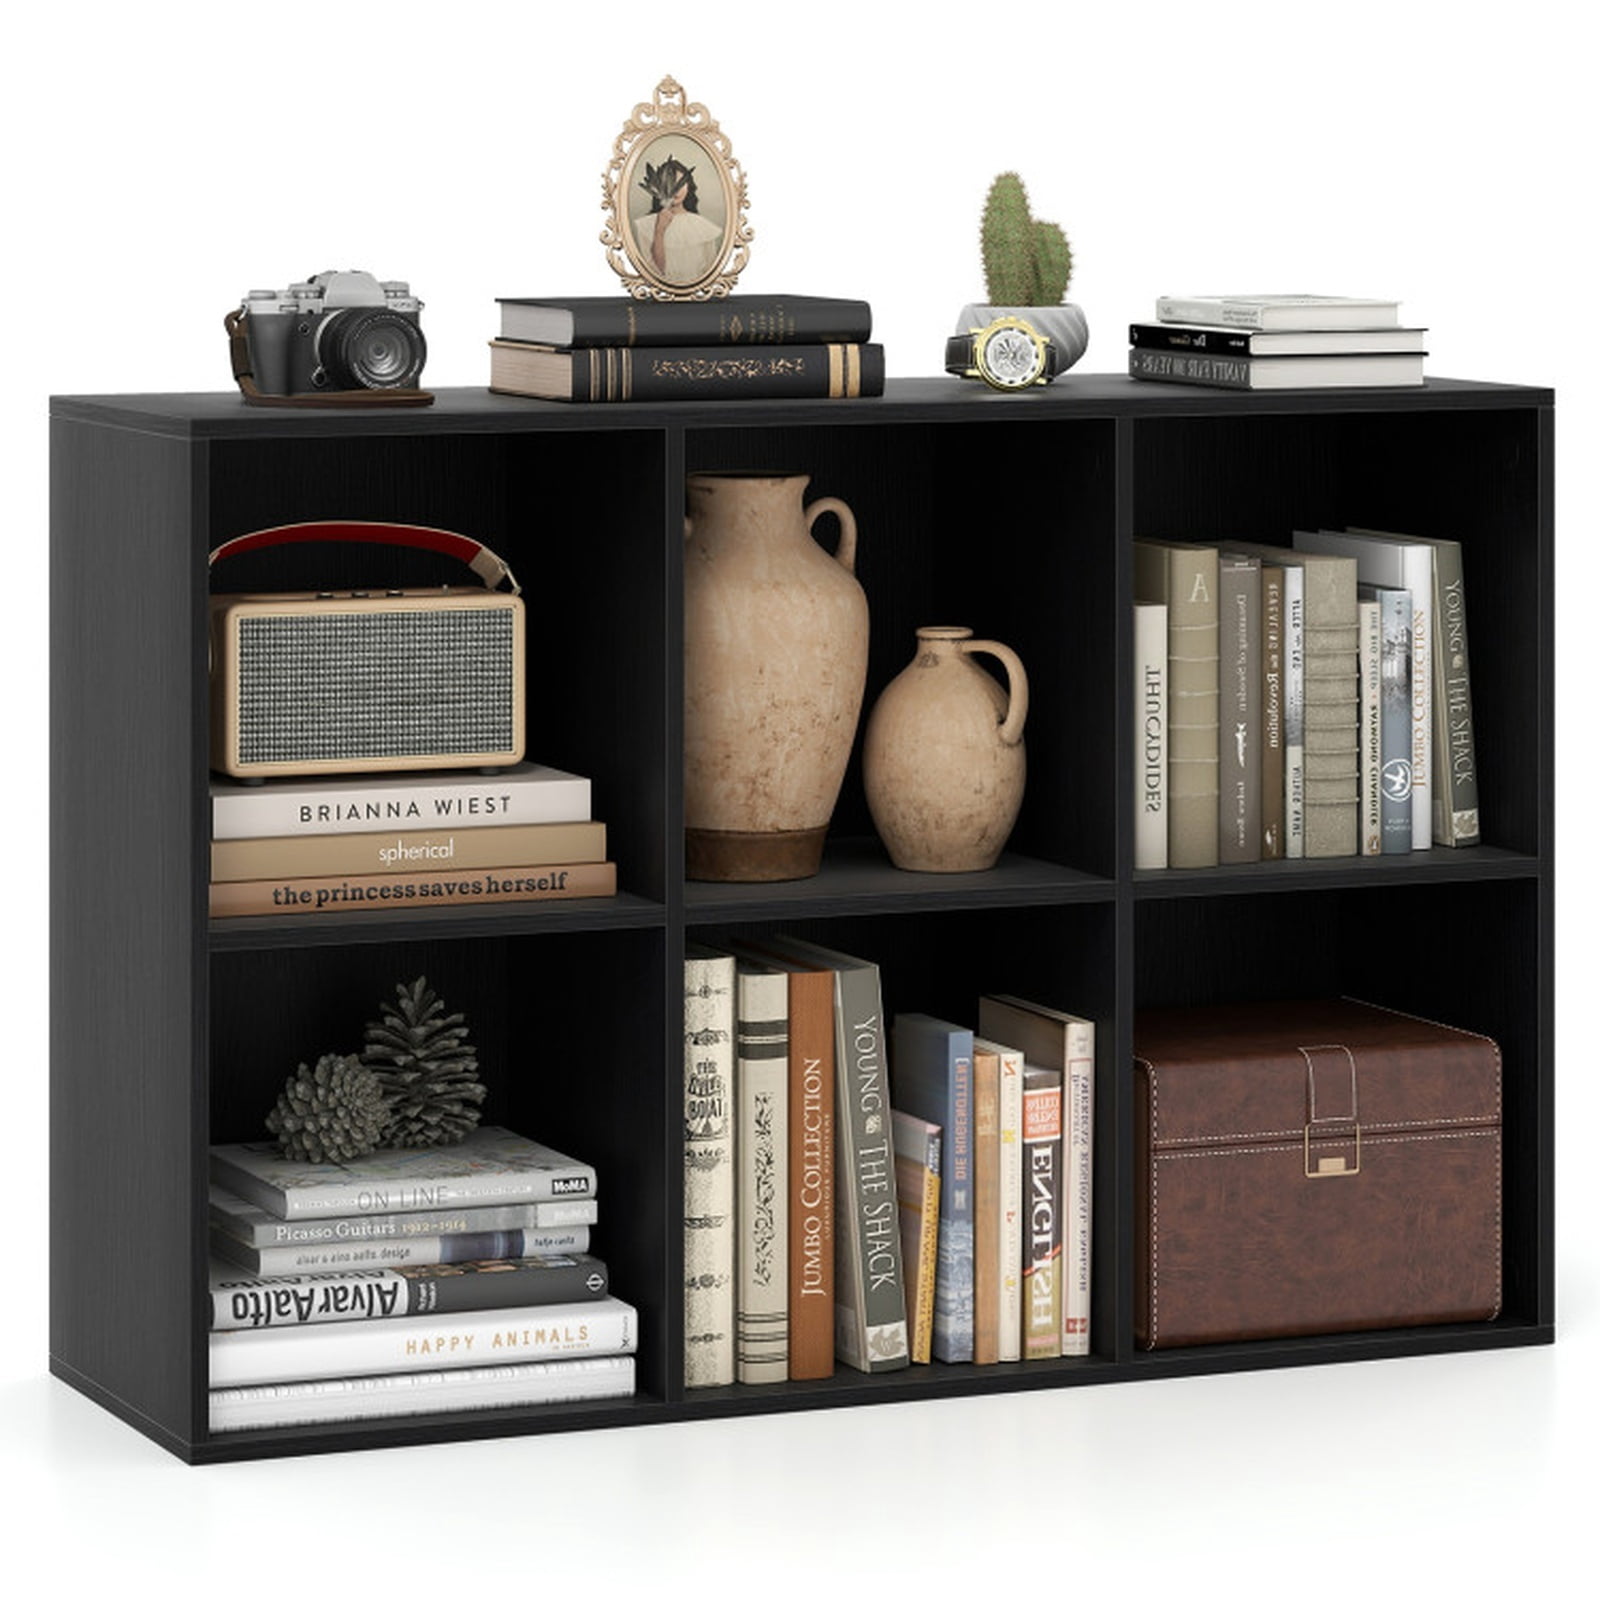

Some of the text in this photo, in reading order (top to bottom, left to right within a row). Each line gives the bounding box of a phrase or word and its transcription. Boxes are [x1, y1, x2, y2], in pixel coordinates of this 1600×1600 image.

[1188, 573, 1210, 603] A
[1412, 610, 1426, 722] COLLECTION
[1444, 579, 1472, 785] YOUNG THE SHACK
[299, 795, 512, 823] BRIANNA WIEST
[378, 838, 454, 865] spherical
[273, 871, 568, 907] the princess saves herself
[852, 1015, 896, 1291] YOUNG THE SHACK
[357, 1189, 390, 1210] ON
[399, 1186, 448, 1209] LINE
[553, 1179, 588, 1193] MoMA
[275, 1221, 332, 1241] Picasso
[336, 1219, 396, 1238] Guitars
[379, 1247, 411, 1260] design
[232, 1287, 314, 1325] Aalto
[317, 1281, 399, 1317] Alvar
[406, 1335, 474, 1355] HAPPY
[492, 1325, 589, 1349] ANIMALS
